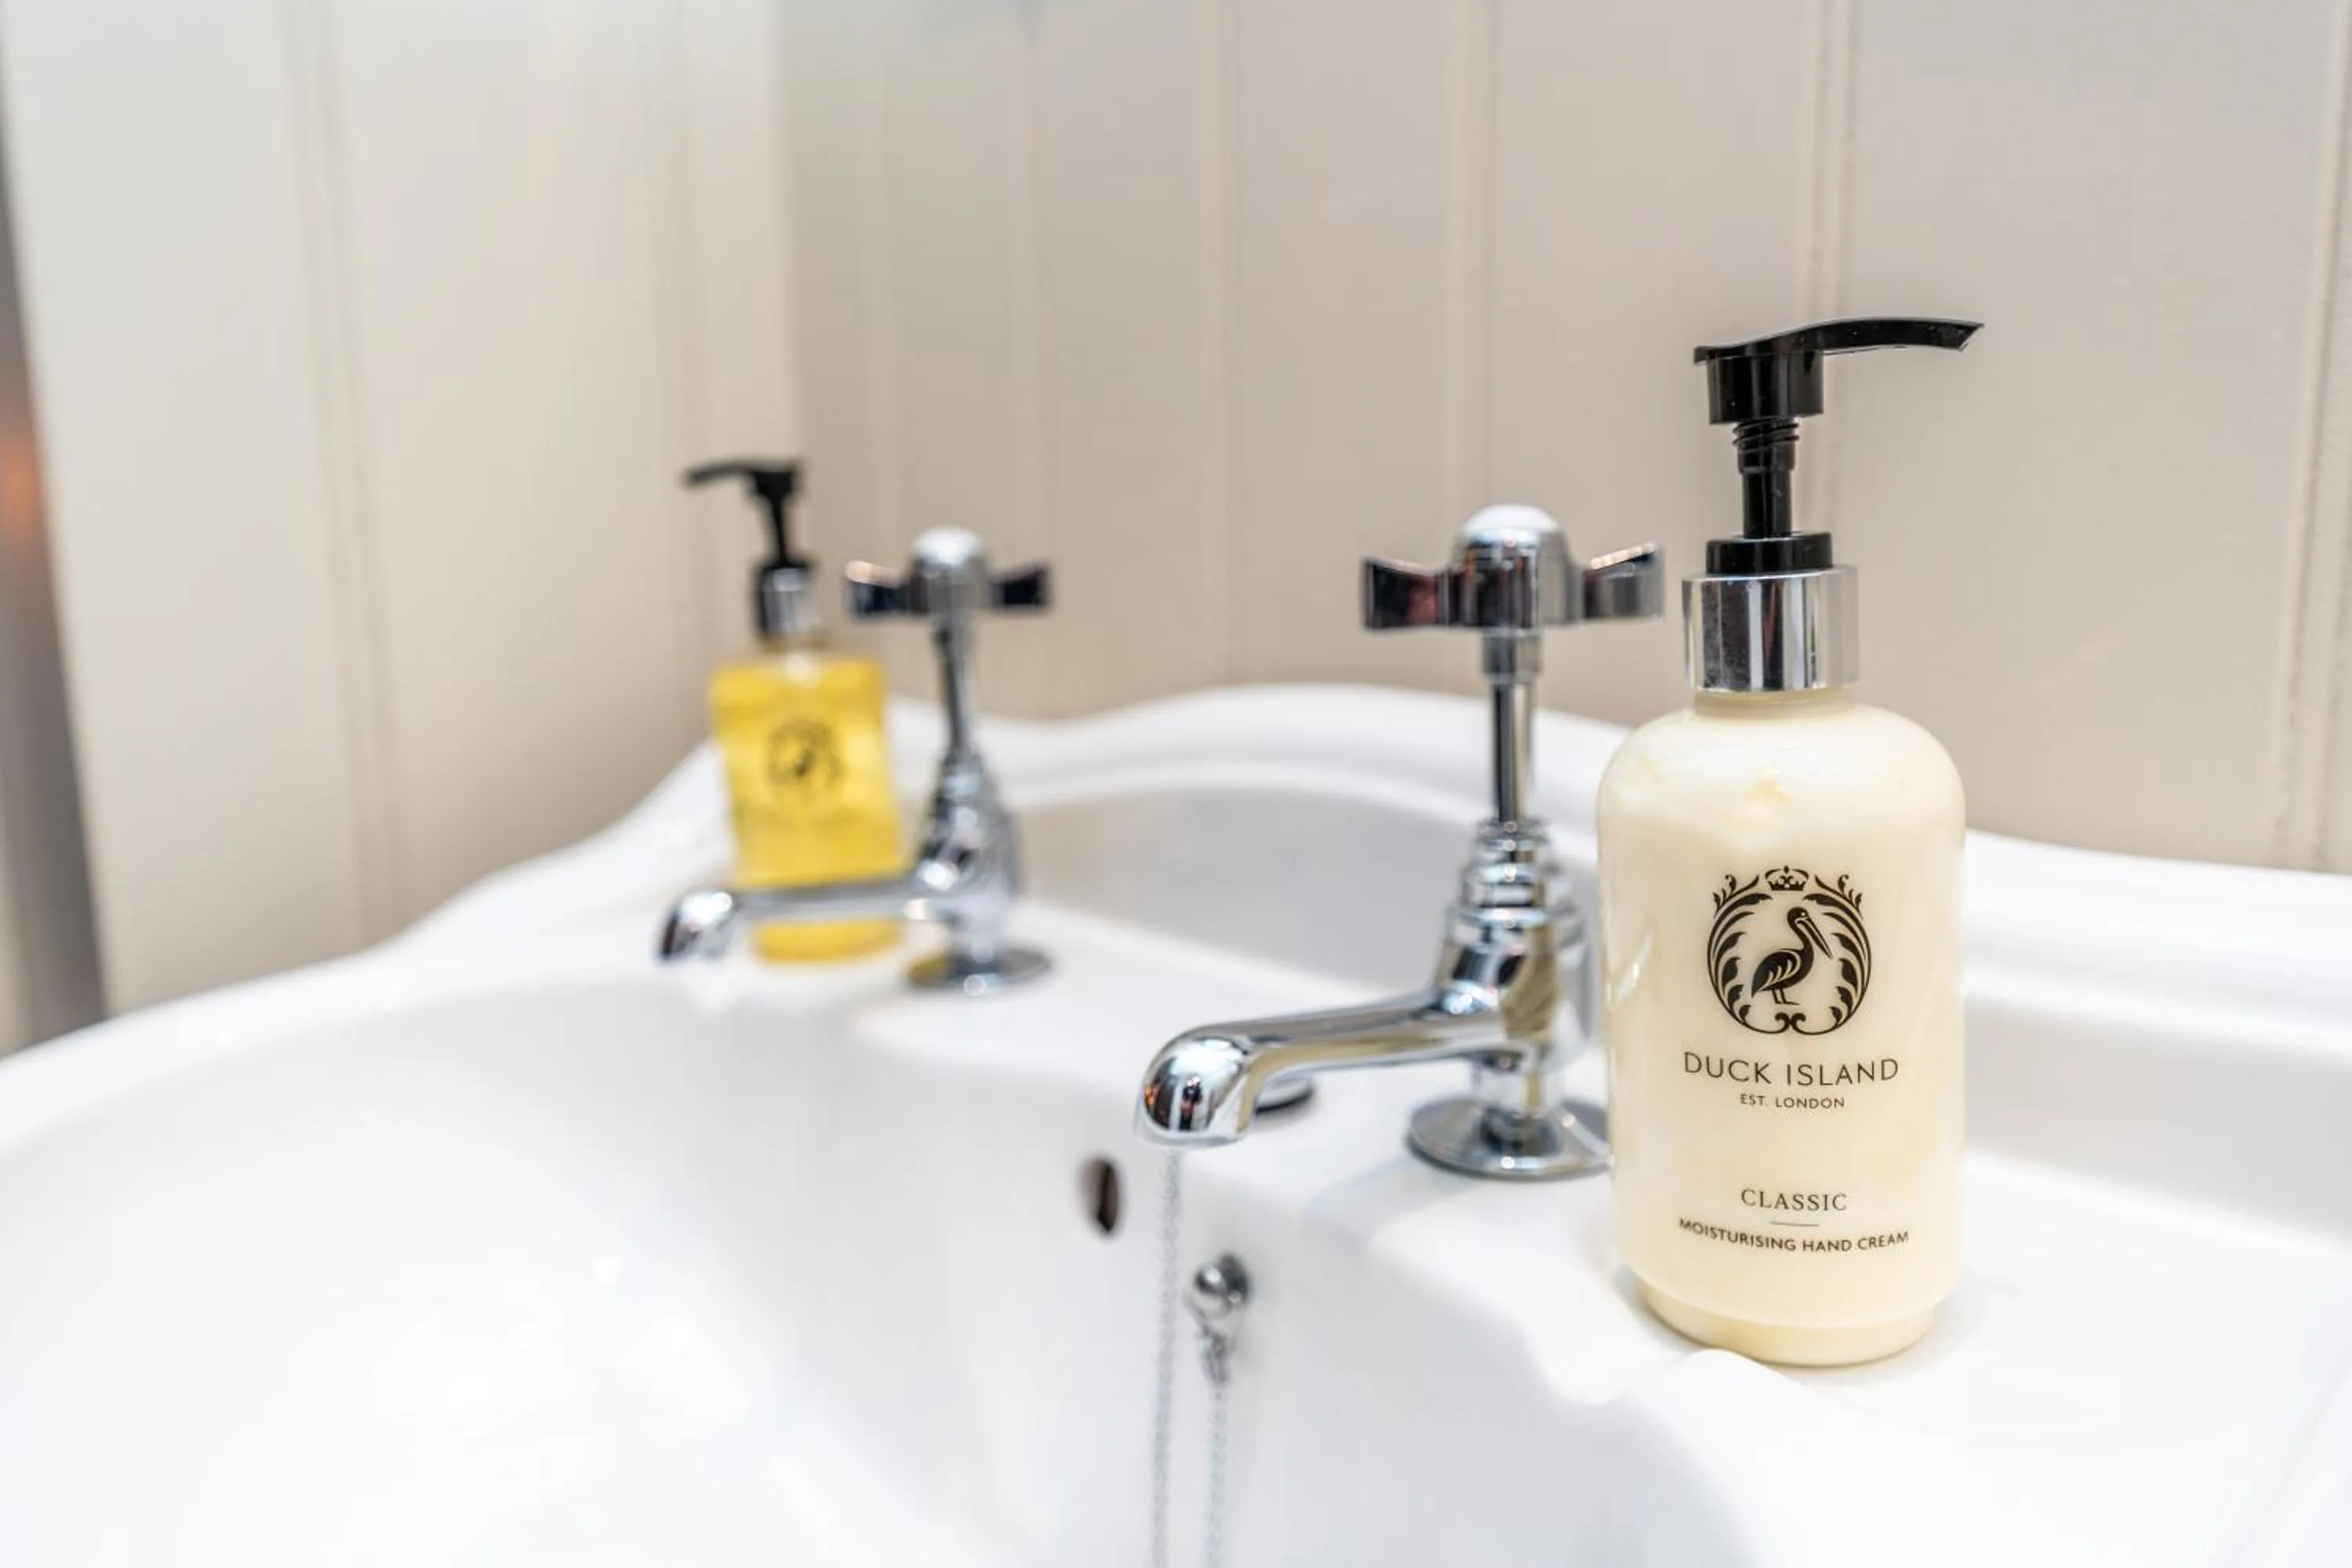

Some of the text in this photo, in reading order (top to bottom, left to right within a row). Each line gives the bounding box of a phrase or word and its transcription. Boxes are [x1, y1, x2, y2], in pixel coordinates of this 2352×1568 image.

[1684, 1051, 1899, 1087] DUCK ISLAND
[1740, 1094, 1845, 1109] EST. LONDON
[1740, 1189, 1848, 1212] CLASSIC
[1679, 1217, 1910, 1253] MOISTURISING HAND CREAM
